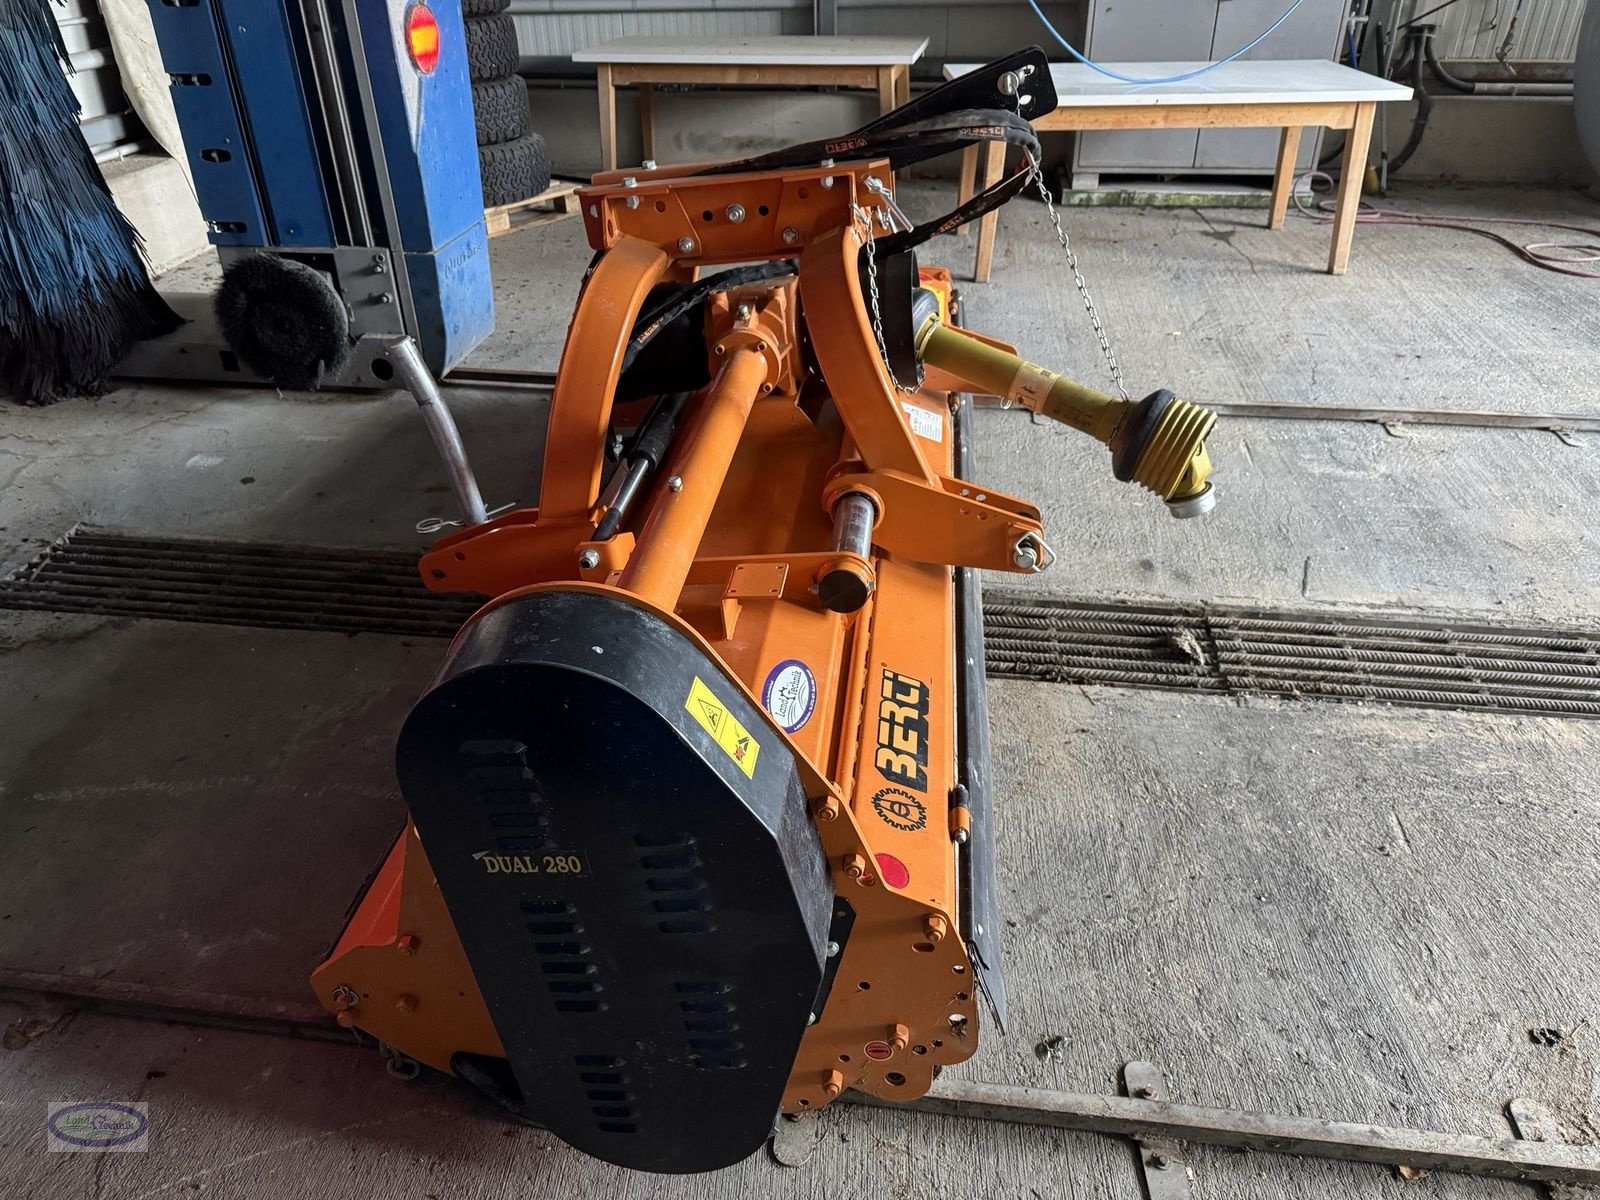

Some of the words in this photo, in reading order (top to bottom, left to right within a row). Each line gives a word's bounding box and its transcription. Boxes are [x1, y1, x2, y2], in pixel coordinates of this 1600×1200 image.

[775, 697, 788, 718] Land
[788, 670, 802, 696] Technik
[482, 856, 539, 873] DUAL
[543, 855, 581, 873] 280
